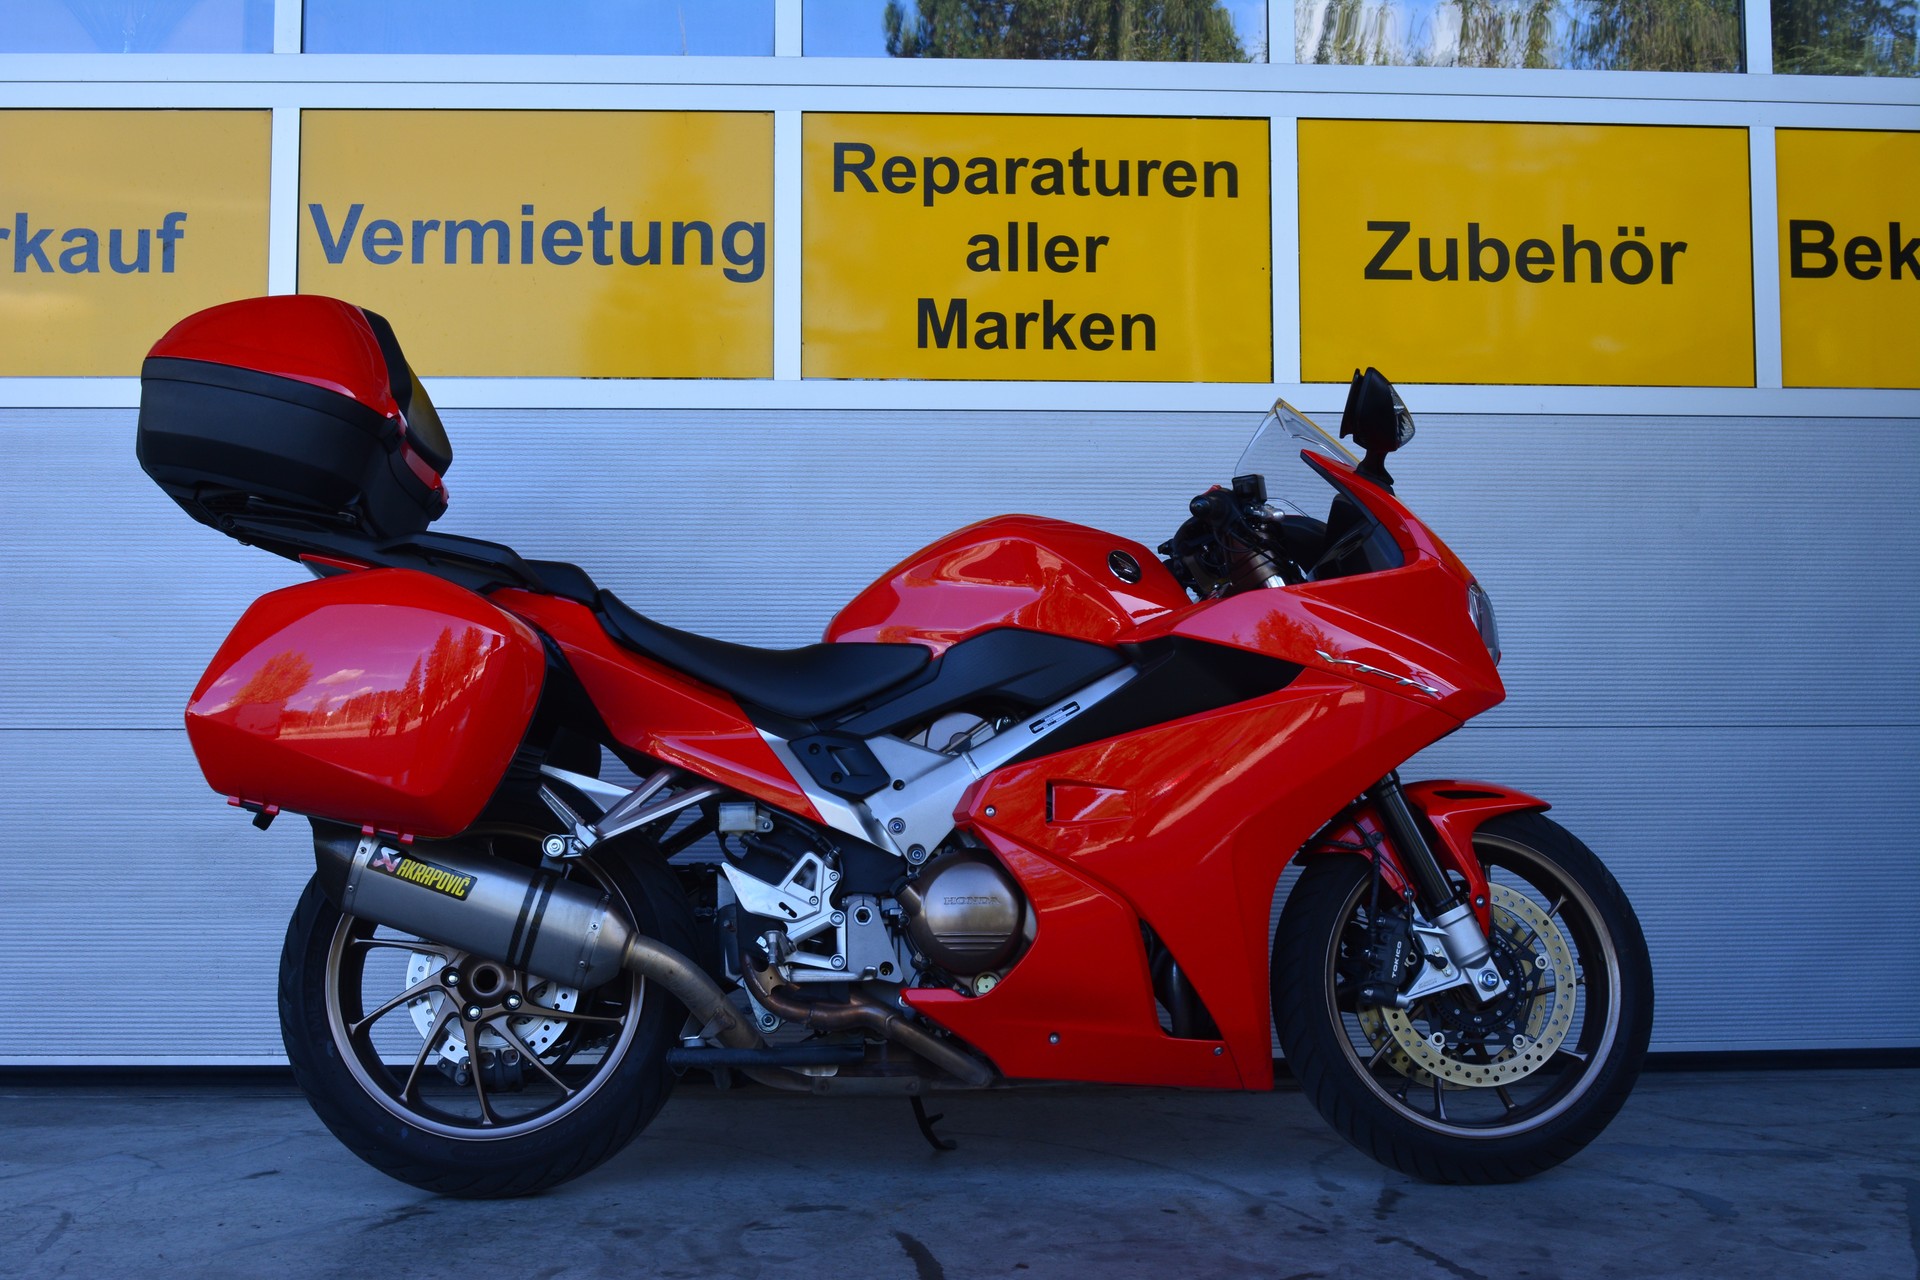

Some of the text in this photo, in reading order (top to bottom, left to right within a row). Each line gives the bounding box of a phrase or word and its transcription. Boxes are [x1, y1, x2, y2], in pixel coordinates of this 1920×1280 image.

[834, 143, 1239, 207] Reparaturen
[309, 204, 766, 284] Vermietung
[967, 222, 1109, 273] aller
[1364, 221, 1688, 285] Zubehör
[1789, 219, 1920, 281] Bek
[918, 298, 1156, 352] Marken
[943, 896, 1001, 906] HONDA
[1391, 940, 1402, 979] TOKICO
